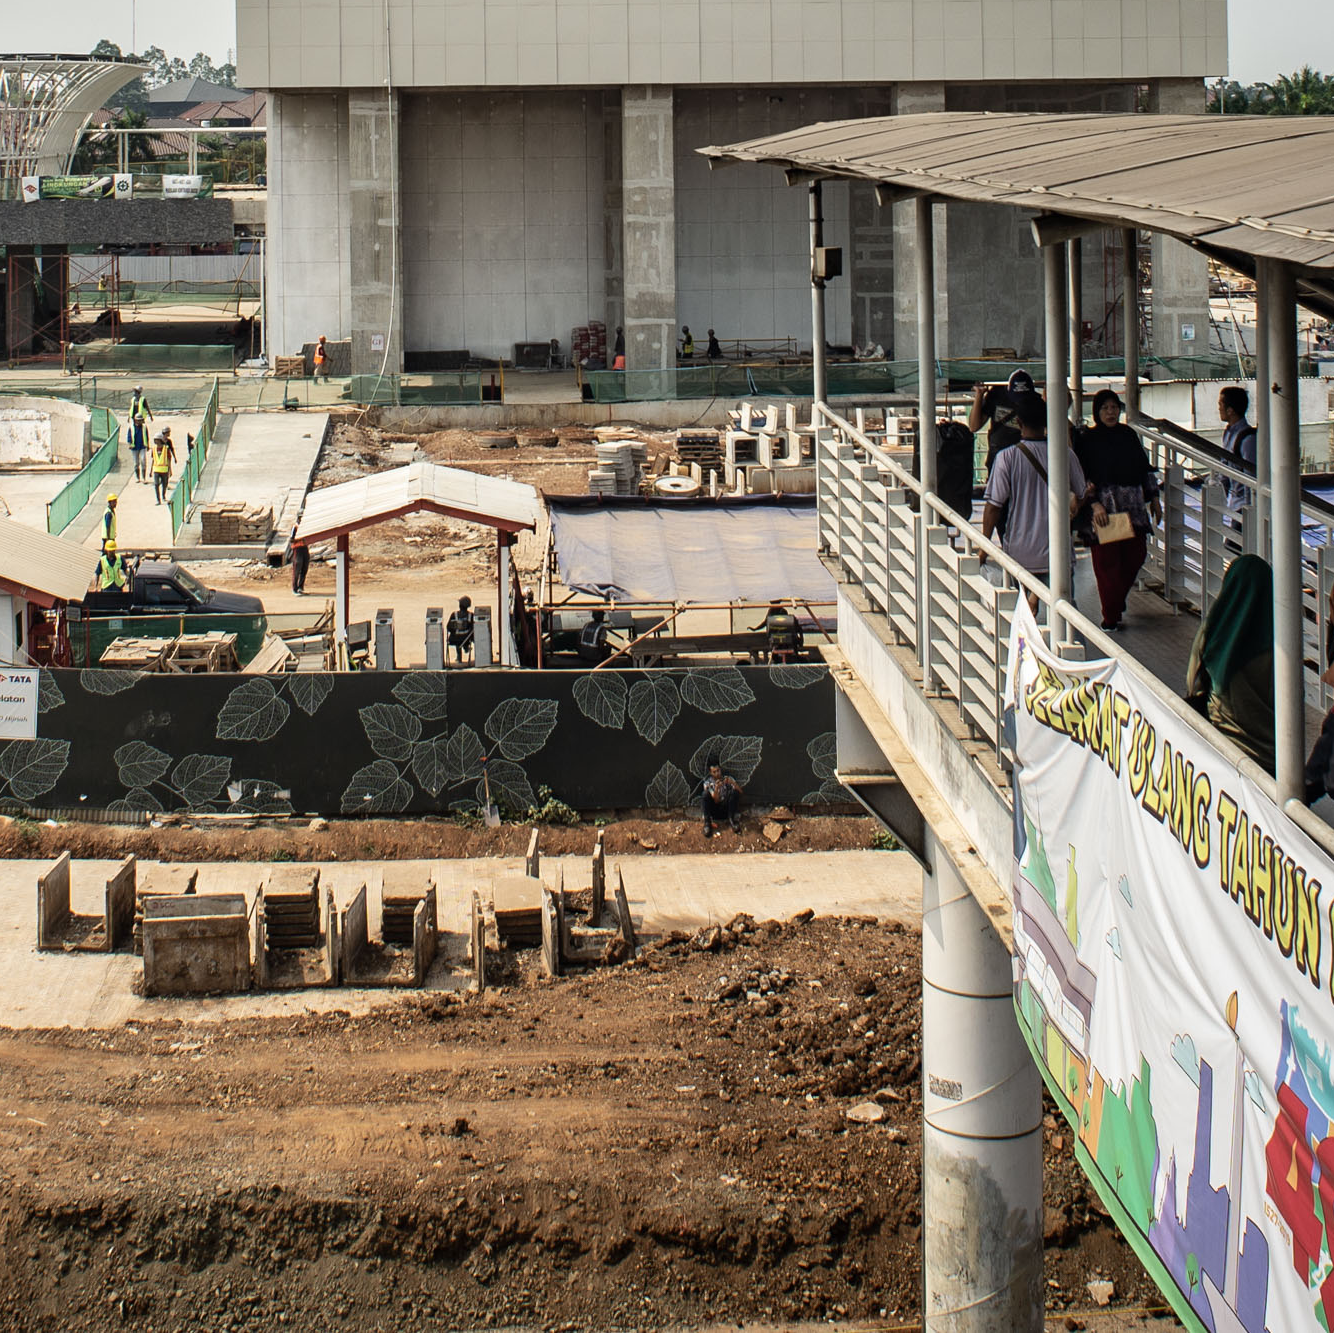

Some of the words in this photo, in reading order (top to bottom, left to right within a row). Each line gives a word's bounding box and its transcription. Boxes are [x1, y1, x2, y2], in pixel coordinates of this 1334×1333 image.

[9, 675, 32, 683] TATA
[1025, 657, 1131, 779] SELAMAT
[1127, 710, 1212, 869] ULANG
[1217, 789, 1322, 983] TAHUN
